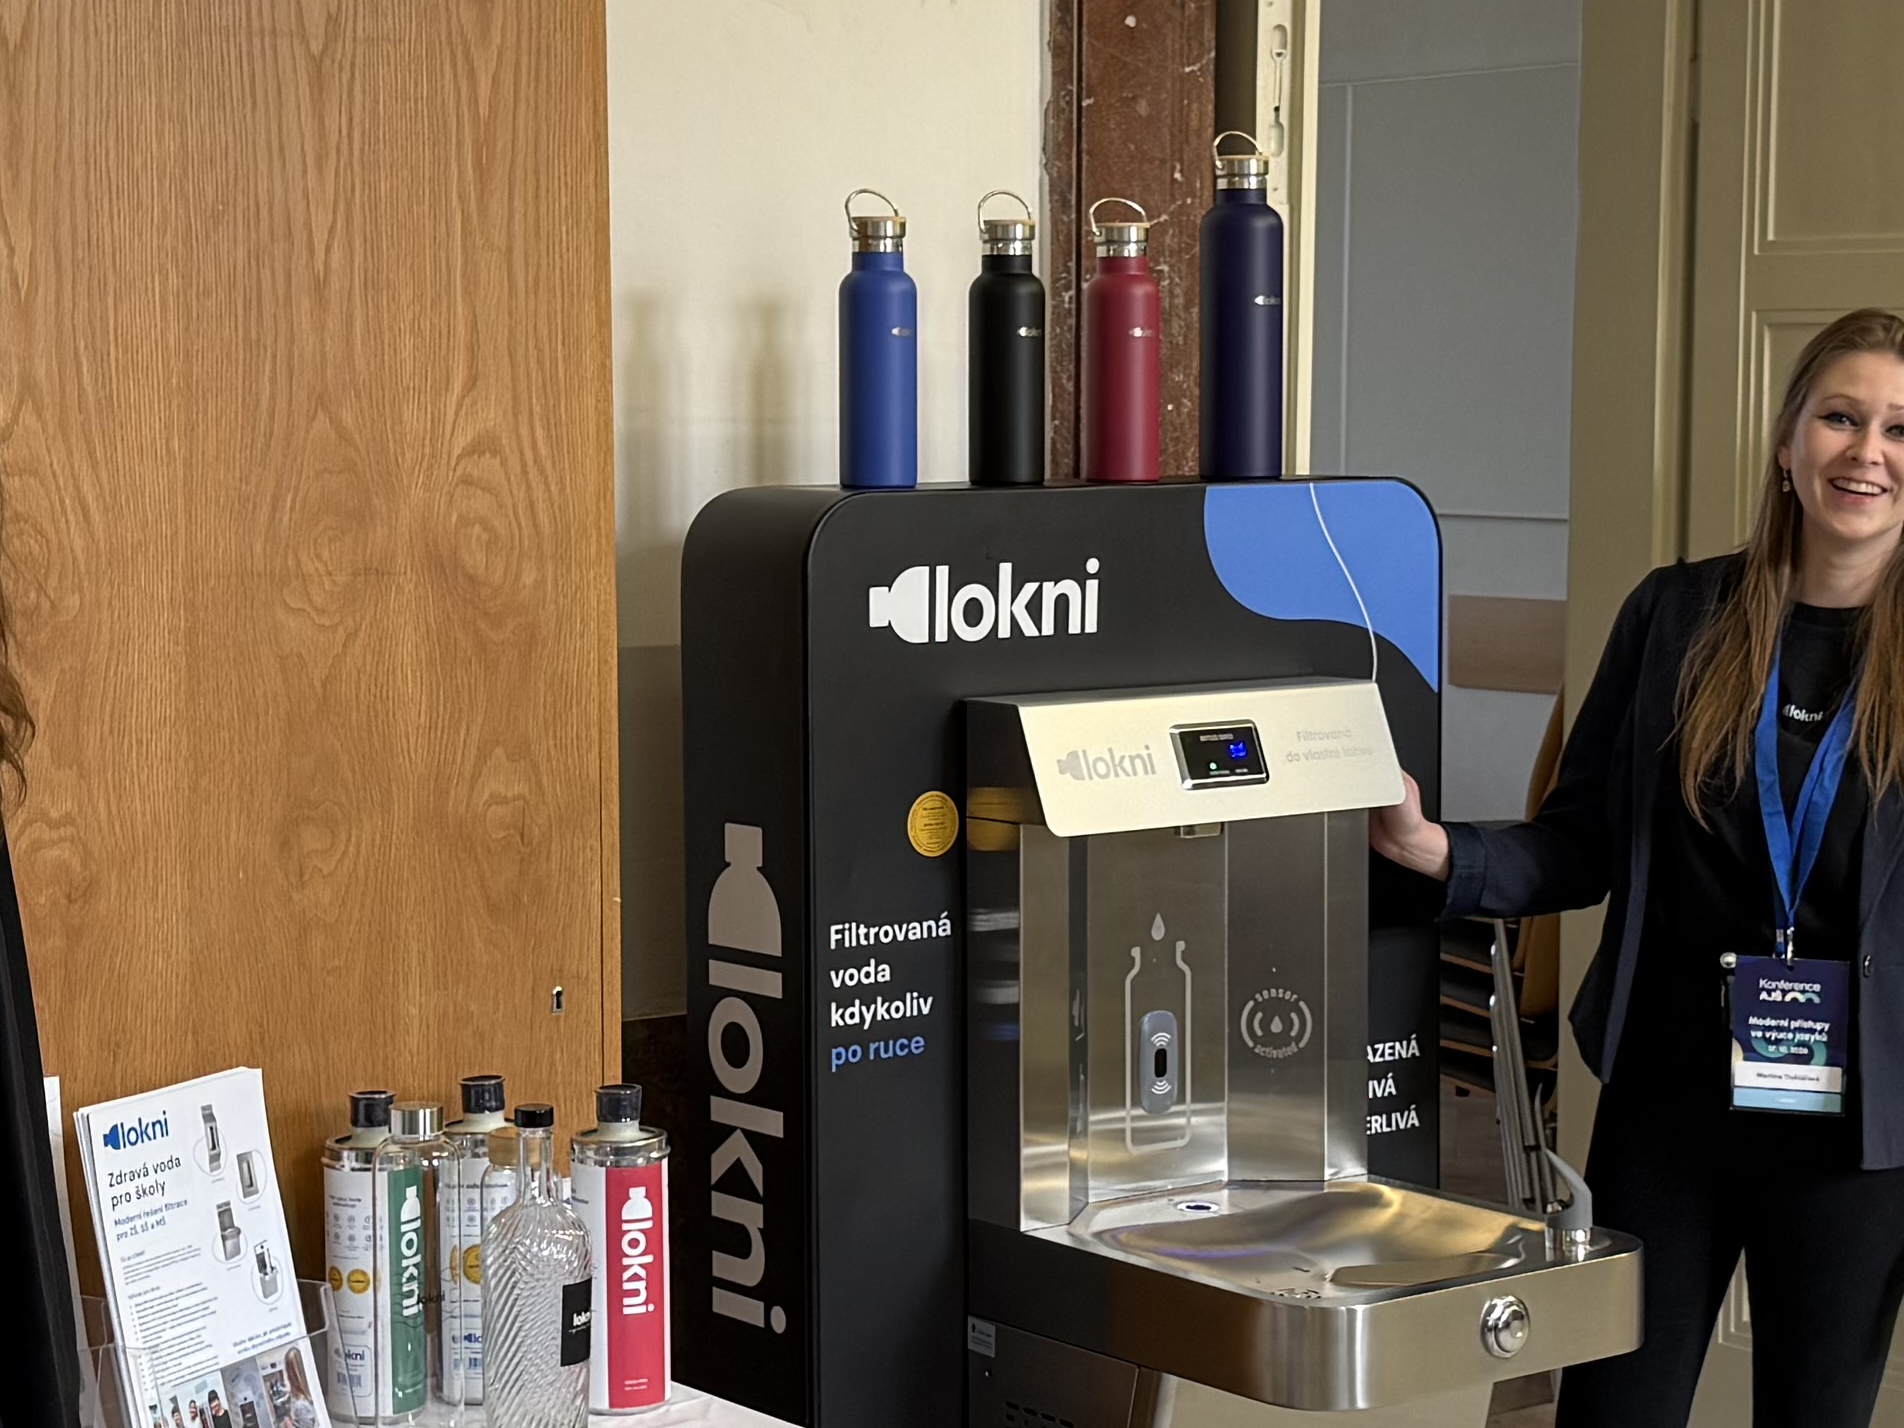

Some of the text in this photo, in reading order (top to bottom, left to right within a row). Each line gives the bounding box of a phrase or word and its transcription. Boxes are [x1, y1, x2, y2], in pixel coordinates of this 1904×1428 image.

[935, 557, 1100, 643] lokni
[1084, 744, 1157, 781] lokni
[829, 911, 952, 950] Filtrovaná
[829, 958, 891, 988] voda
[830, 992, 934, 1030] kdykoliv
[831, 1035, 925, 1073] po ruce
[120, 1109, 170, 1149] lokni
[707, 958, 787, 1335] lokni
[107, 1154, 182, 1188] Zdravá voda
[110, 1180, 167, 1211] pro školy
[400, 1218, 423, 1317] lokni
[621, 1219, 655, 1315] lokni
